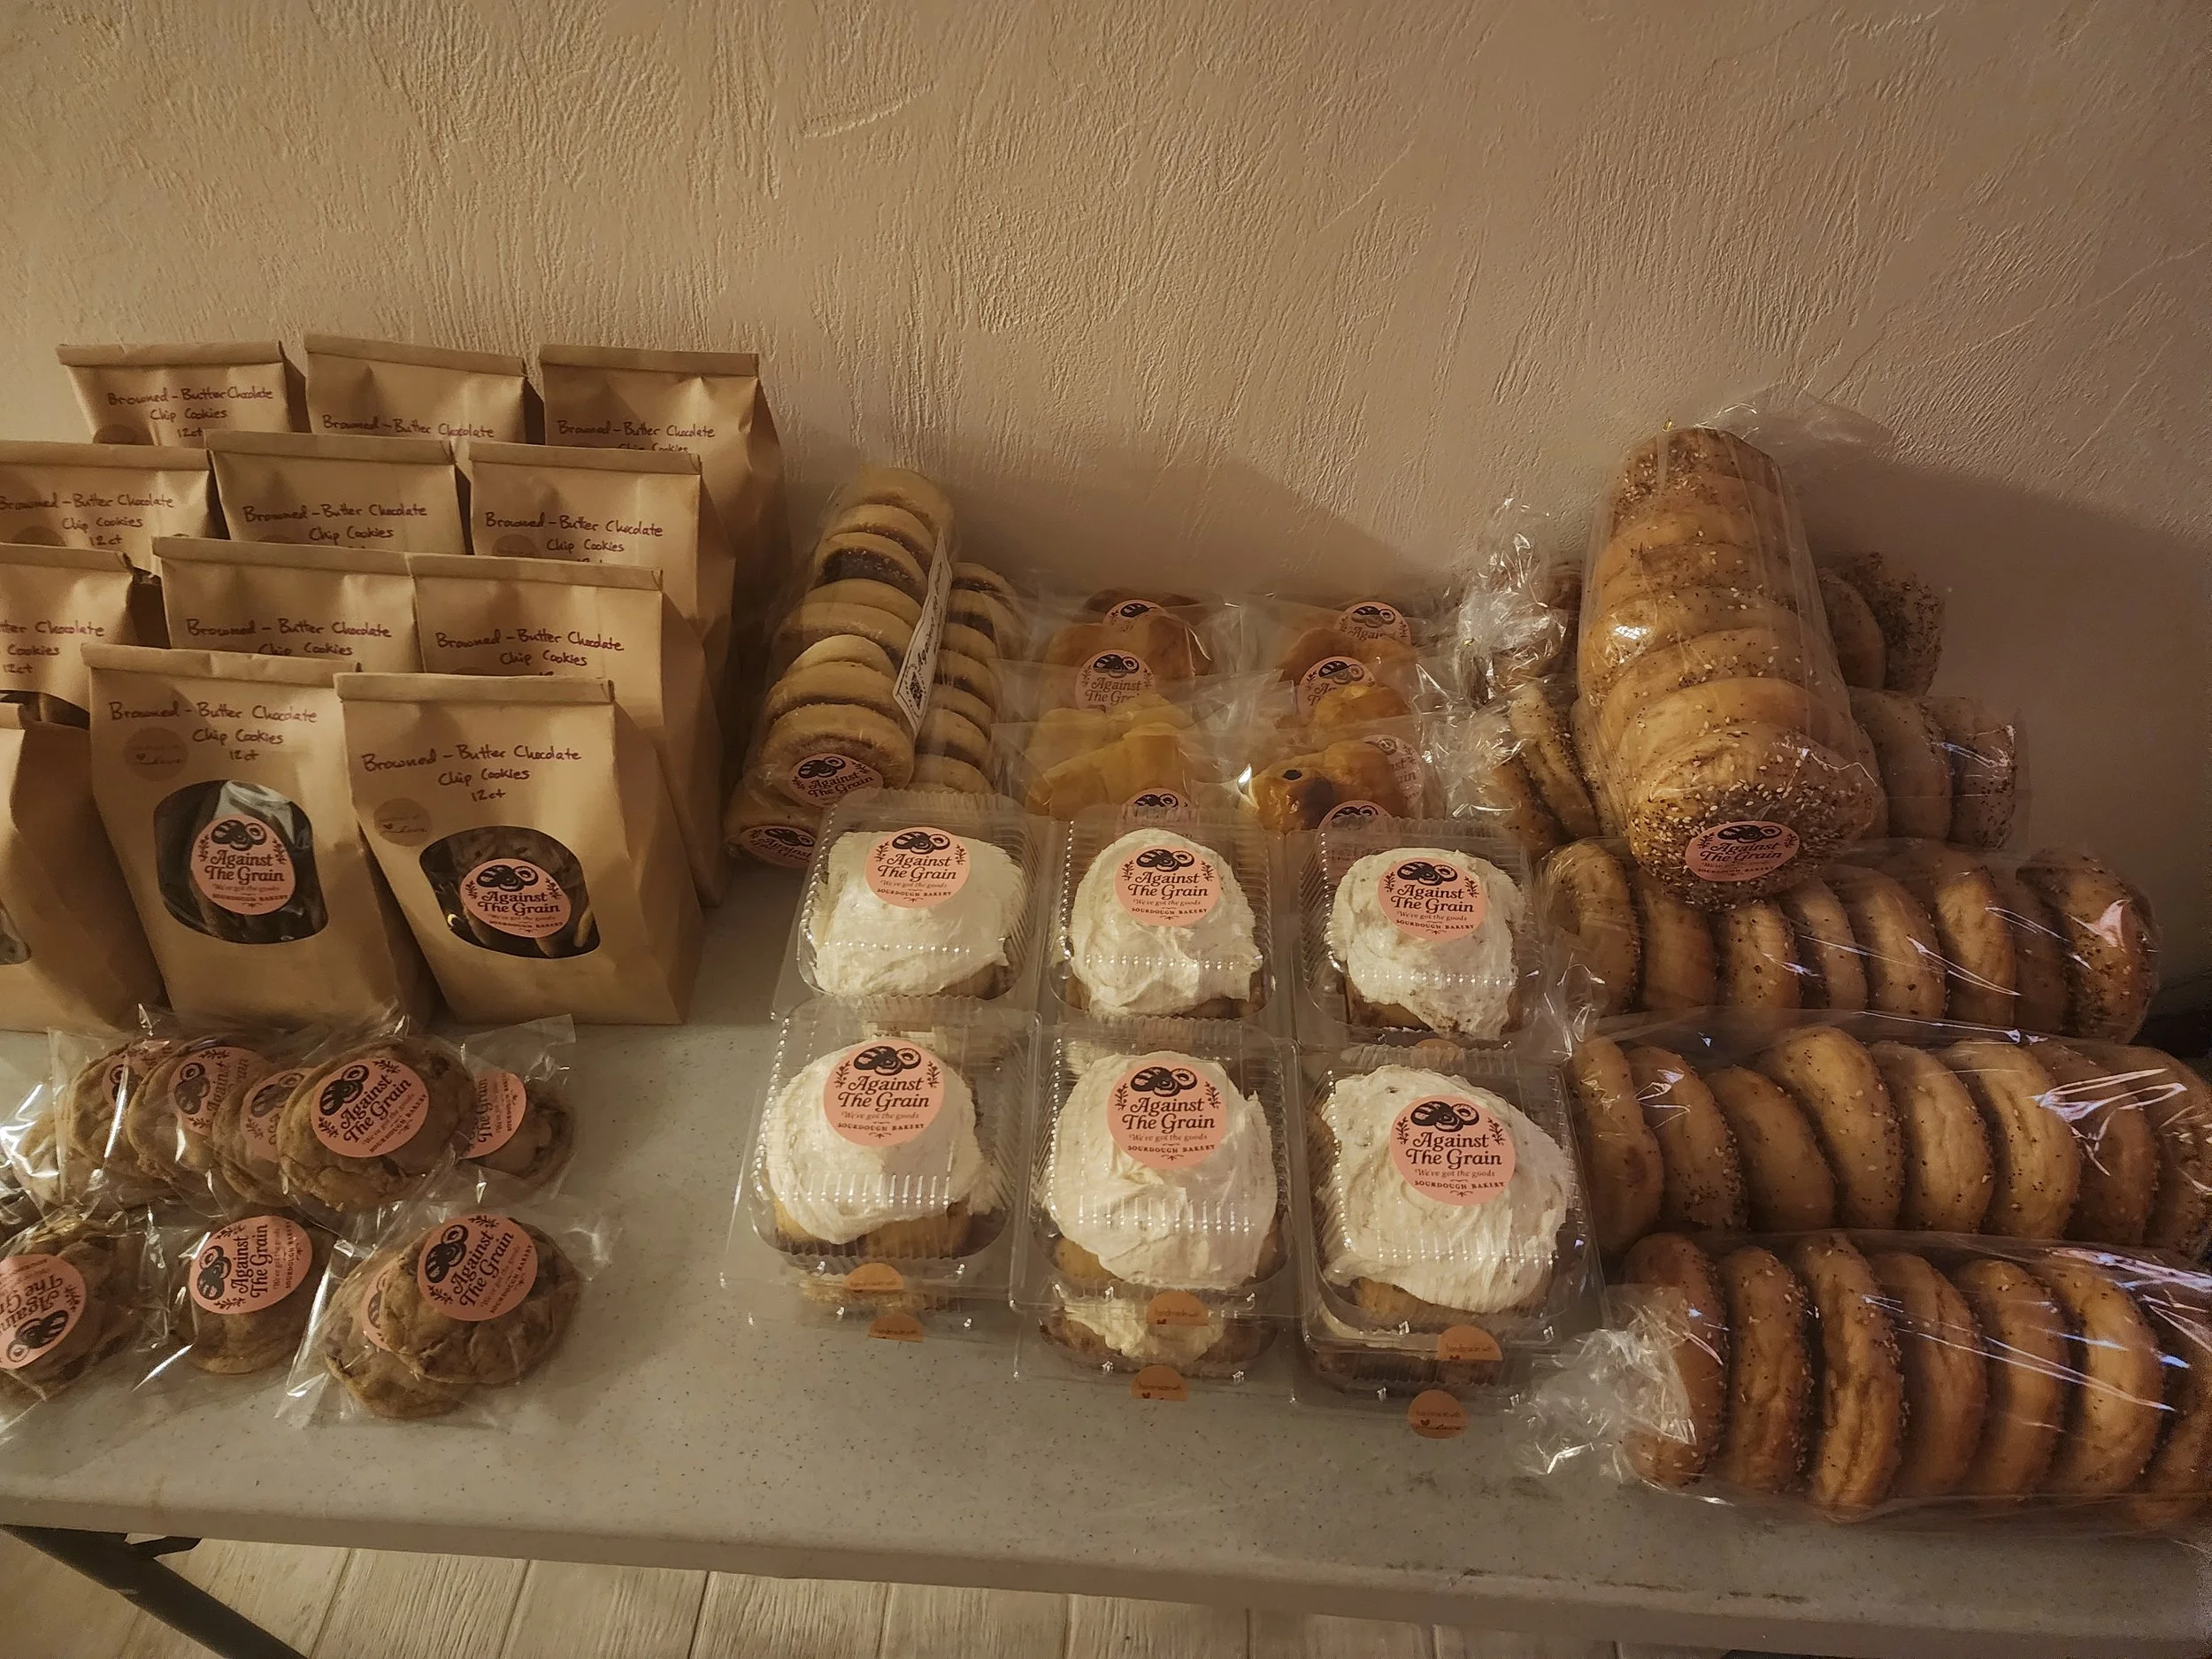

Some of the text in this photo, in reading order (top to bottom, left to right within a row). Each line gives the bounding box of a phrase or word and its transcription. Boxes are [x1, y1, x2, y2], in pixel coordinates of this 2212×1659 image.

[150, 407, 228, 423] Chip Cookies
[62, 516, 143, 534] Chip Cookies
[310, 527, 395, 545] Chip Cookies
[547, 539, 625, 554] Chip Cookies
[304, 642, 353, 657] Cookies
[500, 649, 588, 666] Chip Cookies
[1091, 677, 1141, 692] Against
[1085, 689, 1108, 702] The
[192, 728, 284, 746] Chip Cookies
[437, 767, 531, 787] Chip Cookies
[809, 772, 860, 789] Against
[808, 776, 874, 798] The Grain
[1699, 850, 1785, 862] The Grain
[1710, 842, 1781, 856] Against
[210, 849, 275, 868] Against
[887, 853, 955, 868] Against
[204, 865, 285, 885] The Grain
[877, 865, 956, 882] The Grain
[1135, 872, 1201, 887] Against
[481, 891, 548, 905] Against
[1127, 884, 1209, 900] The Grain
[1397, 885, 1464, 900] Against
[477, 901, 561, 917] The Grain
[1390, 895, 1475, 914] The Grain
[848, 1075, 924, 1094] Against
[341, 1074, 393, 1130] Against
[343, 1117, 374, 1142] The
[371, 1079, 412, 1120] Grain
[837, 1092, 930, 1112] The Grain
[1130, 1097, 1205, 1117] Against
[476, 1113, 494, 1143] The
[1122, 1113, 1215, 1133] The Grain
[1413, 1132, 1488, 1152] Against
[1405, 1148, 1502, 1170] The Grain
[231, 1235, 254, 1294] Against
[250, 1224, 273, 1298] The Grain
[450, 1230, 495, 1294] Against
[460, 1278, 488, 1306] The
[480, 1232, 514, 1279] Grain
[25, 1273, 64, 1296] The
